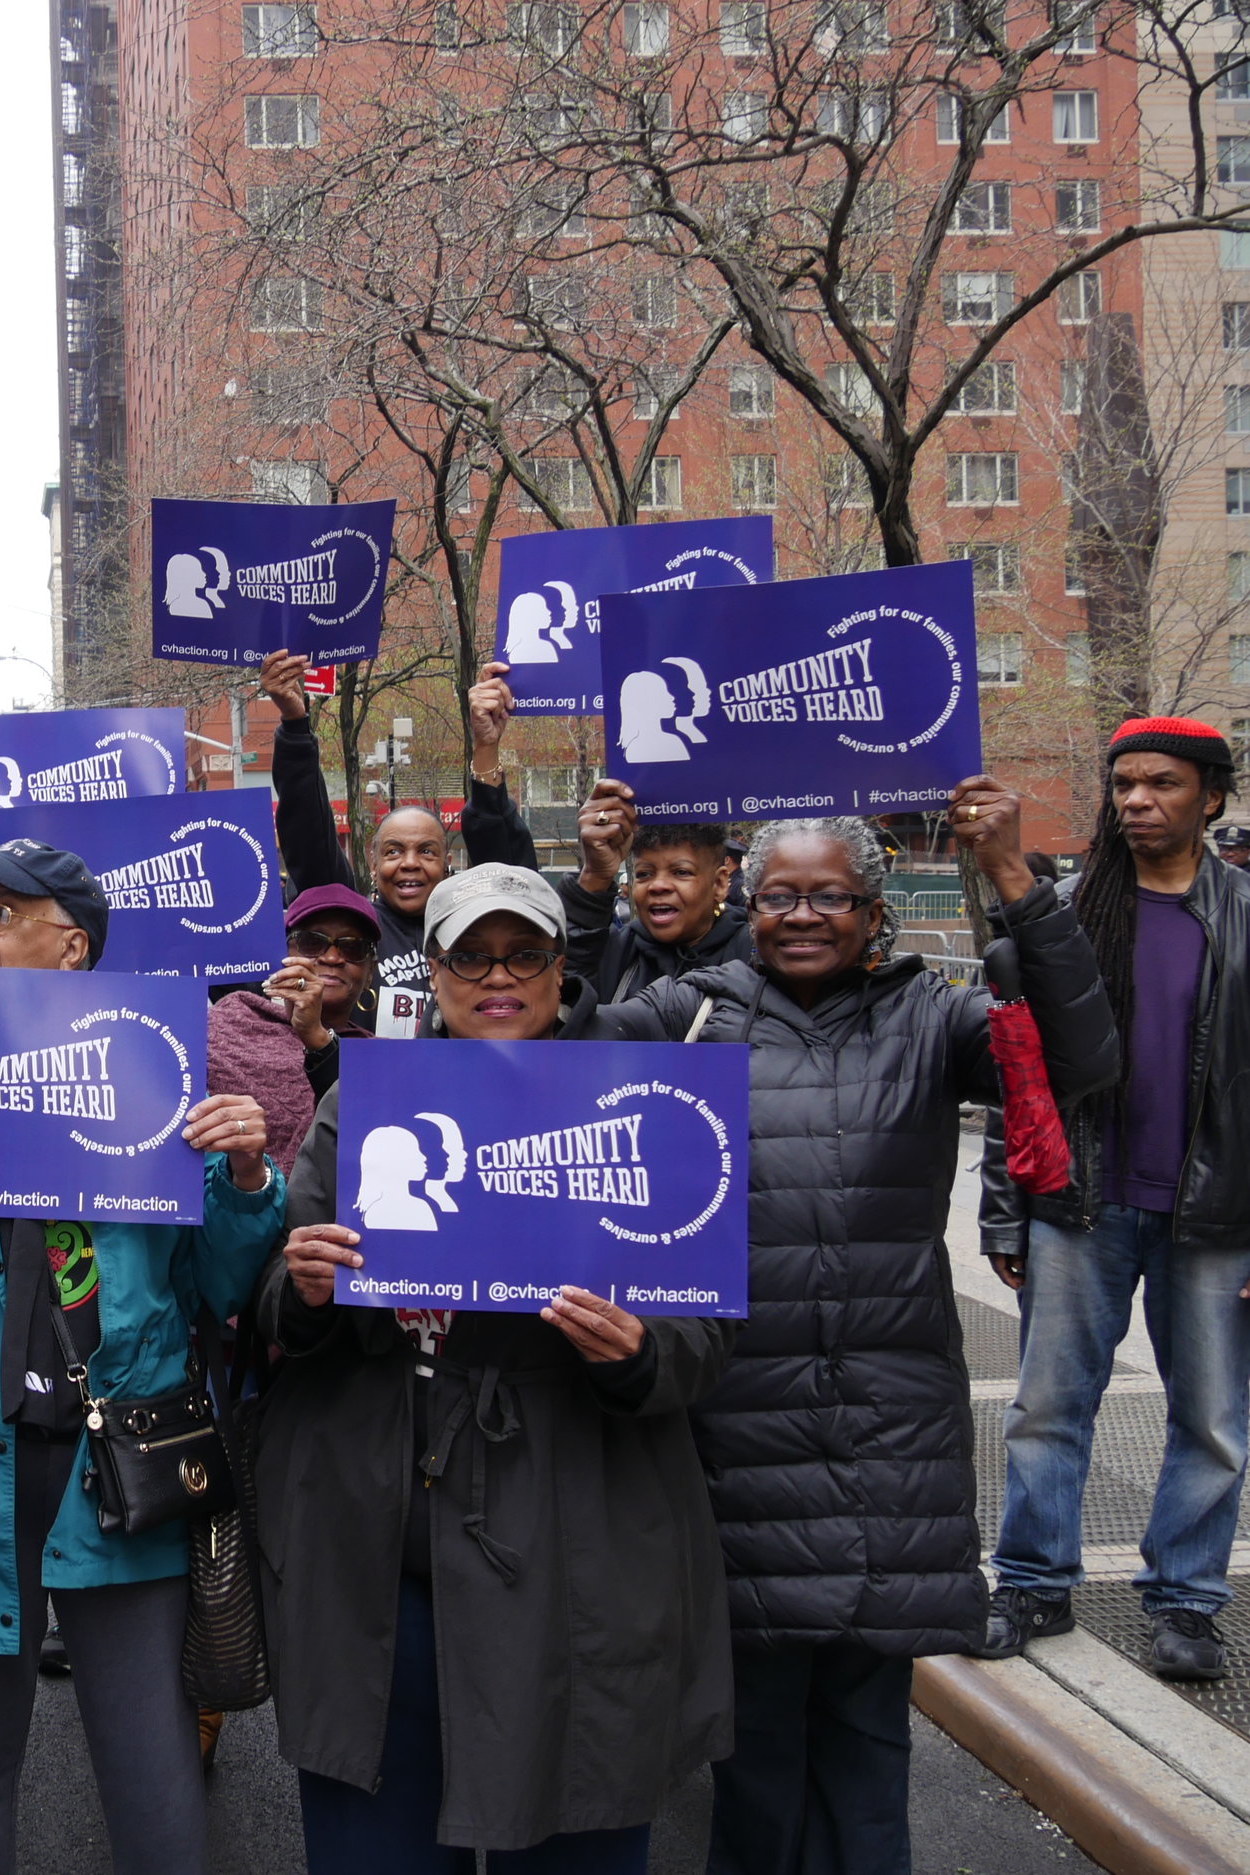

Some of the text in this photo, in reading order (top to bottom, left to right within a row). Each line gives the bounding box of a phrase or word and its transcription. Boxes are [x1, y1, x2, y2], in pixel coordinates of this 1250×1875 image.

[310, 530, 342, 548] Fighting
[344, 527, 355, 536] for
[355, 530, 367, 540] our
[236, 549, 337, 584] COMMUNITY
[665, 550, 701, 570] Fighting
[703, 547, 718, 556] for
[718, 551, 734, 562] our
[237, 581, 336, 605] VOICES HEARD
[346, 578, 378, 620] communities
[308, 614, 337, 625] ourselves
[161, 644, 228, 660] cvhaction.org
[318, 645, 365, 660] #cvhaction
[719, 638, 872, 703] COMMUNITY
[827, 605, 961, 753] Fighting for our families, our communities & ourselves
[512, 697, 575, 709] haction.org
[722, 686, 884, 722] VOICES HEARD
[96, 732, 126, 749] Fighting
[127, 729, 139, 738] for
[140, 734, 153, 744] our
[153, 740, 174, 769] families,
[27, 750, 122, 788] COMMUNITY
[28, 785, 75, 802] VOICES
[634, 802, 718, 816] haction.org
[742, 793, 833, 813] @cvhaction
[94, 842, 204, 894] OMMUNITY
[170, 817, 268, 933] Fighting for our families, our communities & ourselves
[105, 879, 214, 909] OICES HEARD
[205, 960, 270, 976] #cvhaction
[70, 1007, 191, 1156] Fighting for our families, our communities & ourselves
[42, 1085, 116, 1121] HEARD
[476, 1114, 642, 1169] COMMUNITY
[596, 1080, 731, 1244] Fighting for our families, our communities & ourselves
[94, 1194, 177, 1211] #cvhaction
[478, 1167, 649, 1206] VOICES HEARD
[350, 1278, 462, 1300] cvhaction.org
[627, 1286, 718, 1303] #cvhaction
